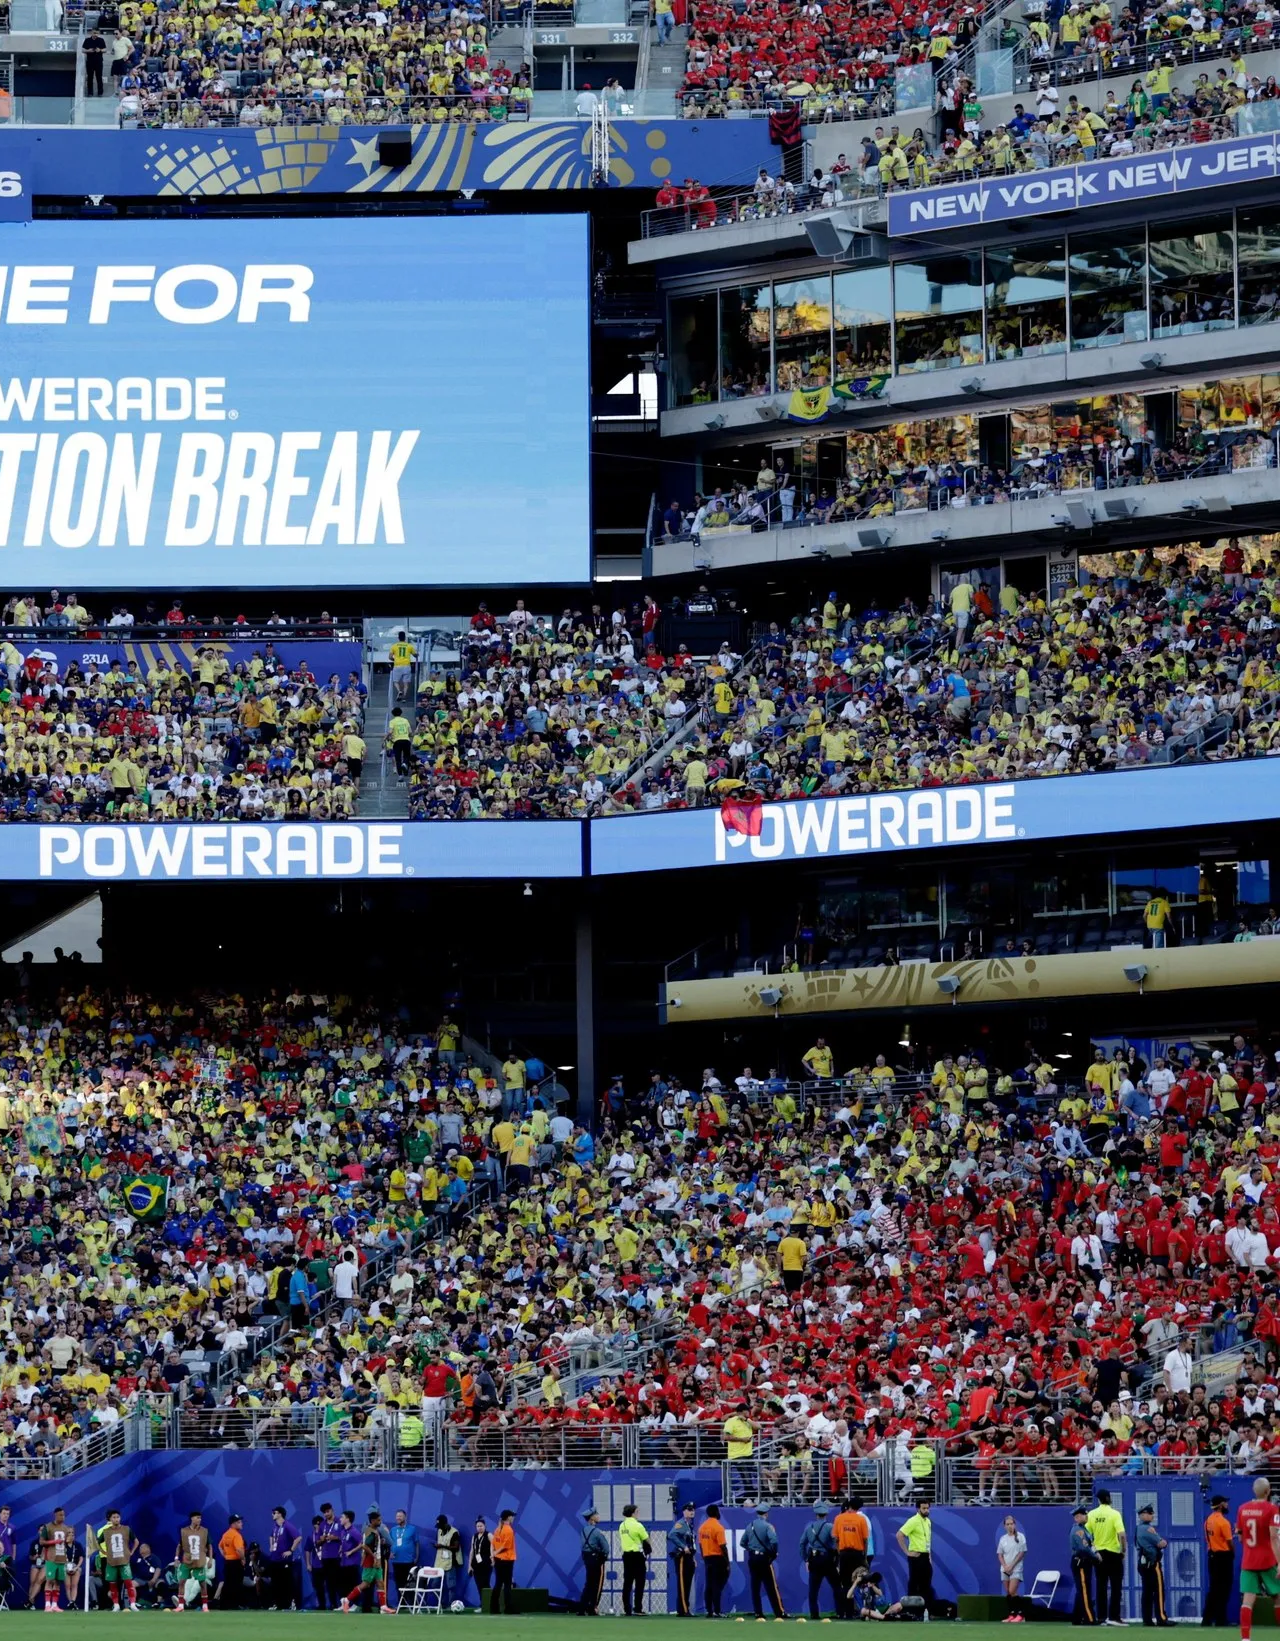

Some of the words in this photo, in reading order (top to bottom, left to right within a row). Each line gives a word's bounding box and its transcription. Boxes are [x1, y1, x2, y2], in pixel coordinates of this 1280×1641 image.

[49, 40, 69, 50] 331
[541, 34, 561, 44] 331
[613, 33, 633, 43] 332
[910, 190, 990, 222] NEW
[998, 172, 1100, 207] YORK
[1108, 157, 1192, 191] NEW
[1200, 144, 1280, 176] JER
[88, 263, 314, 325] FOR
[164, 429, 421, 547] BREAK
[82, 653, 110, 664] 231A
[1245, 1518, 1257, 1548] 3
